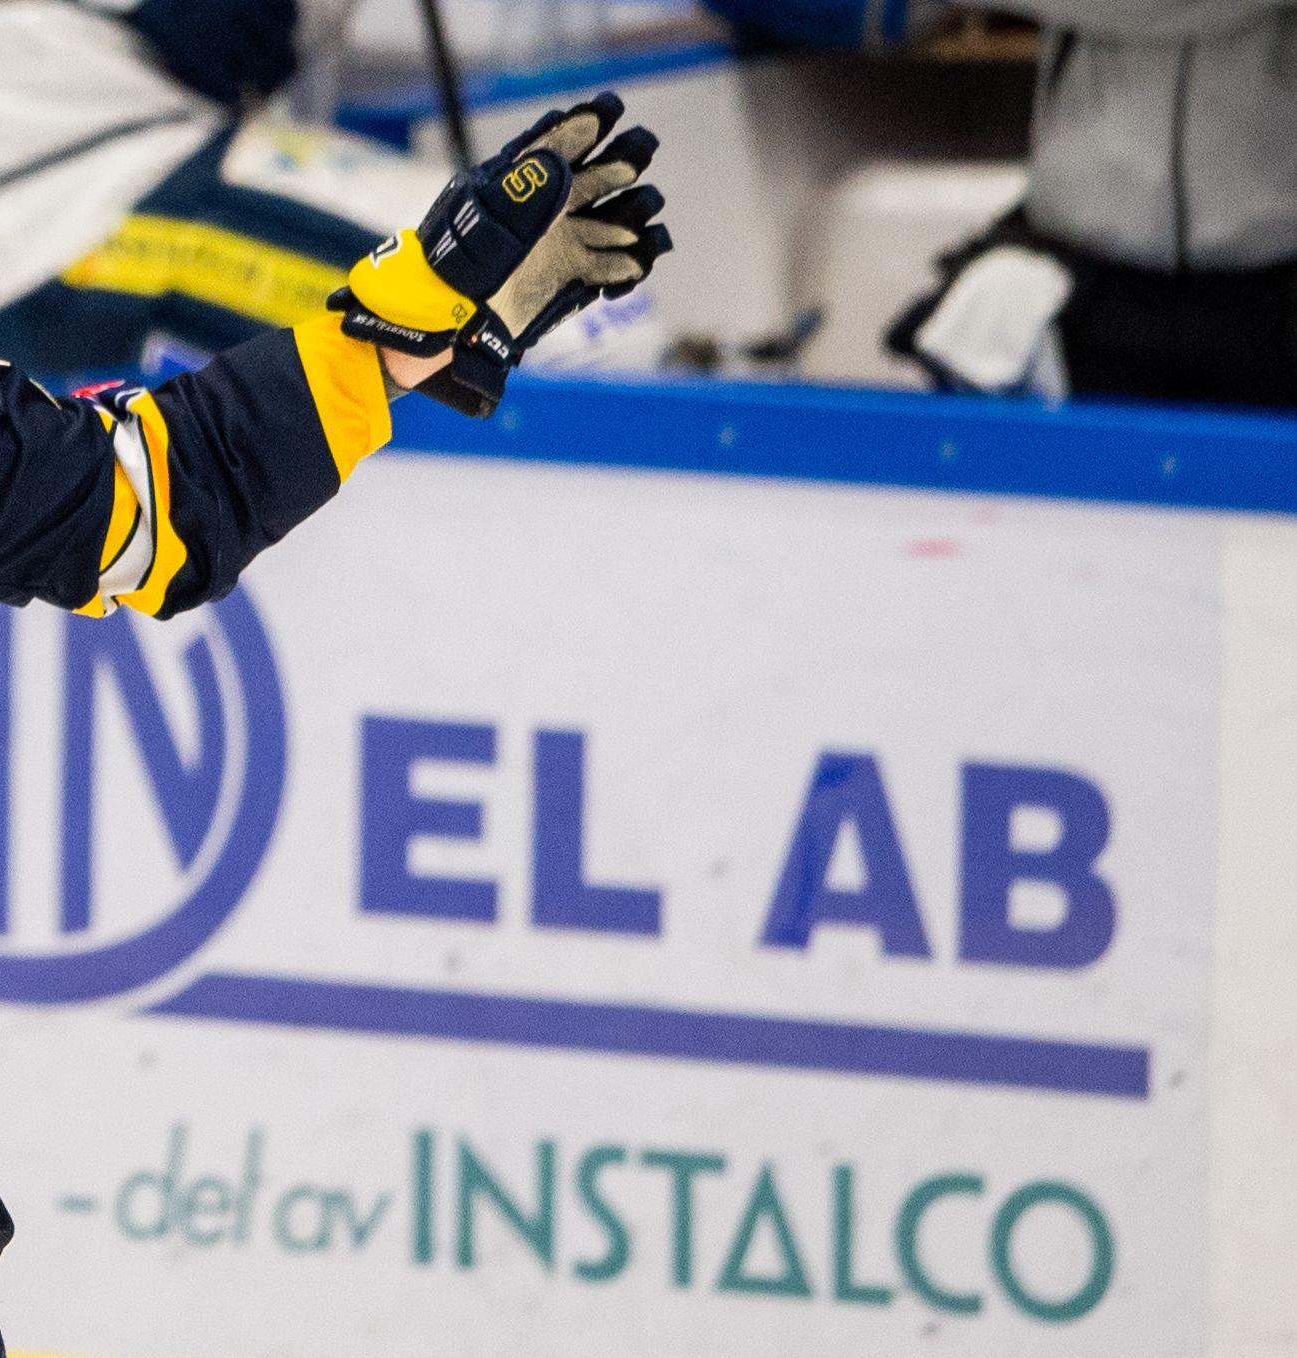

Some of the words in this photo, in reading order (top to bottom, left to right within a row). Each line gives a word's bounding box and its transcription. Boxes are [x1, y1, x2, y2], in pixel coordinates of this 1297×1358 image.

[357, 713, 663, 936] EL
[758, 750, 1118, 973] AB
[272, 1183, 397, 1253] av
[413, 1126, 1117, 1324] INSTALCO
